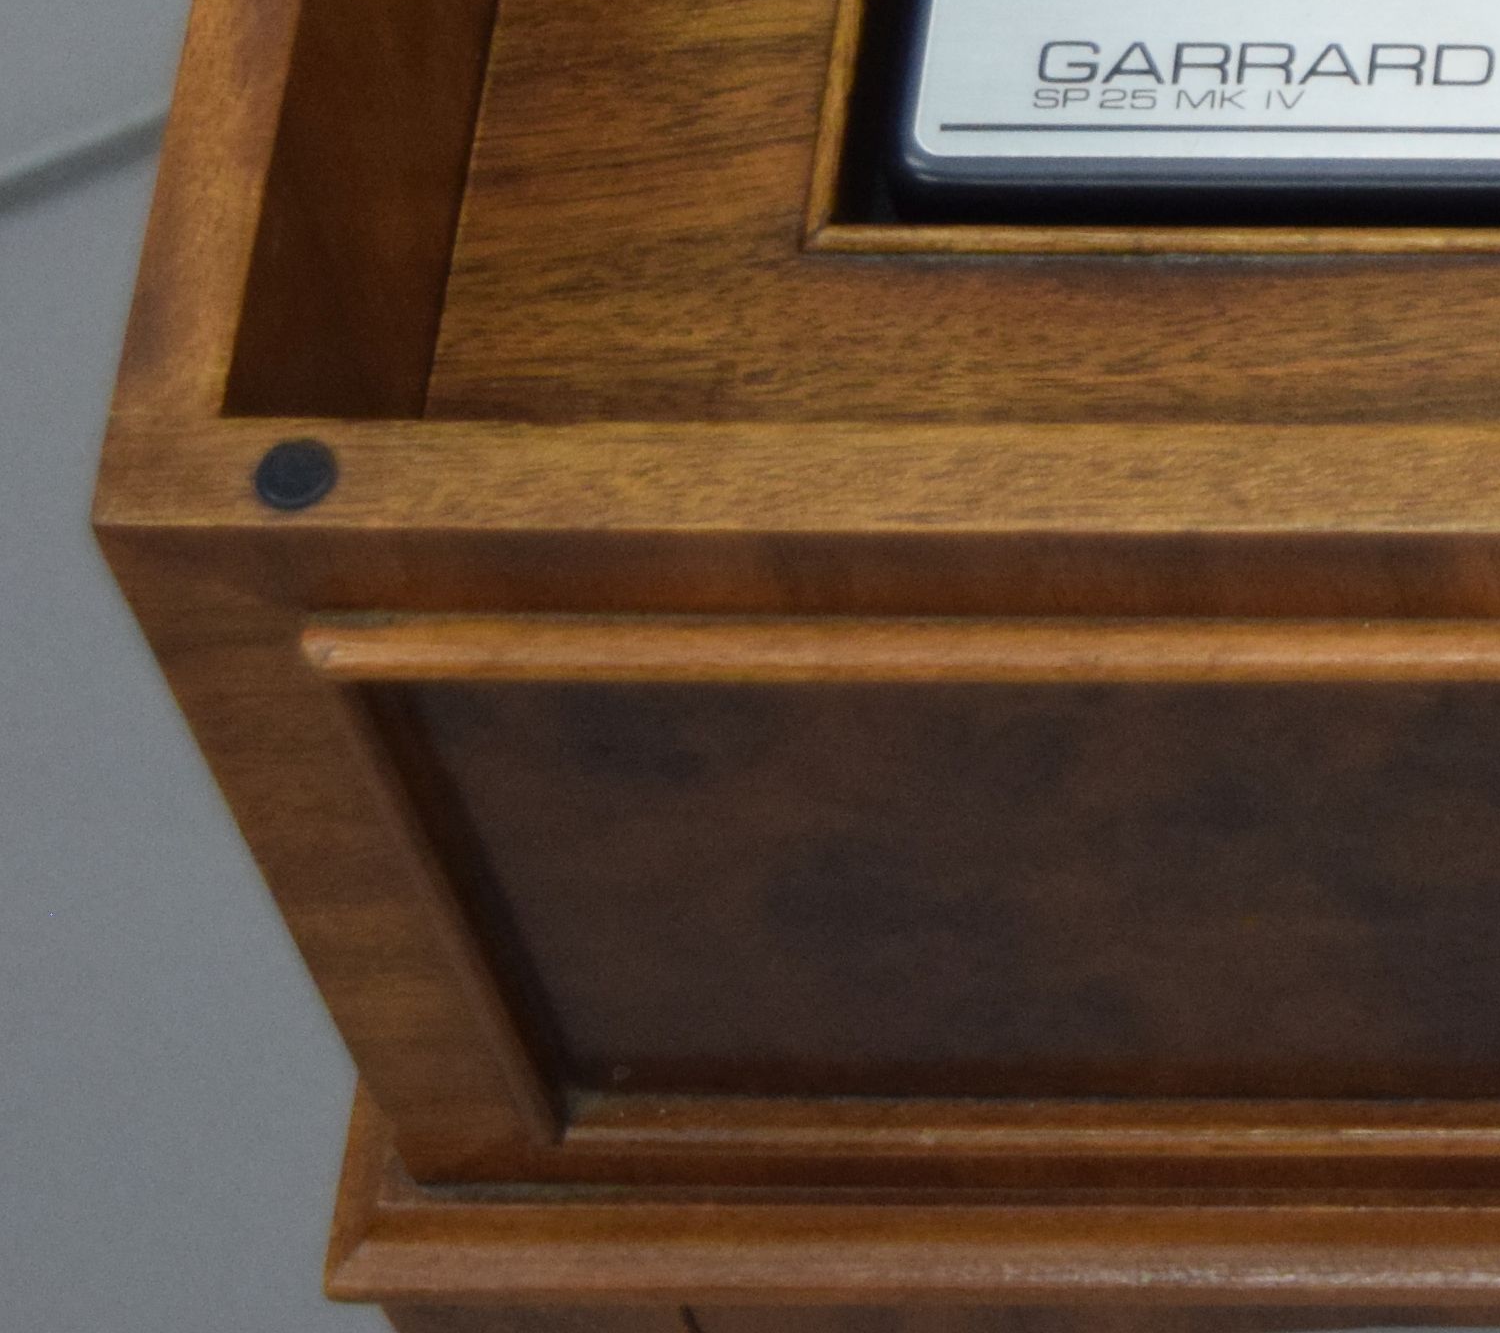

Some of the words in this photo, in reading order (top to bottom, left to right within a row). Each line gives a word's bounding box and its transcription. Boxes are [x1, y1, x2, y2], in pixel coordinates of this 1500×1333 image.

[1037, 39, 1497, 86] GARRARD
[1033, 88, 1090, 109] SP
[1098, 88, 1156, 110] 25
[1176, 89, 1243, 109] MK
[1264, 89, 1305, 110] IV
